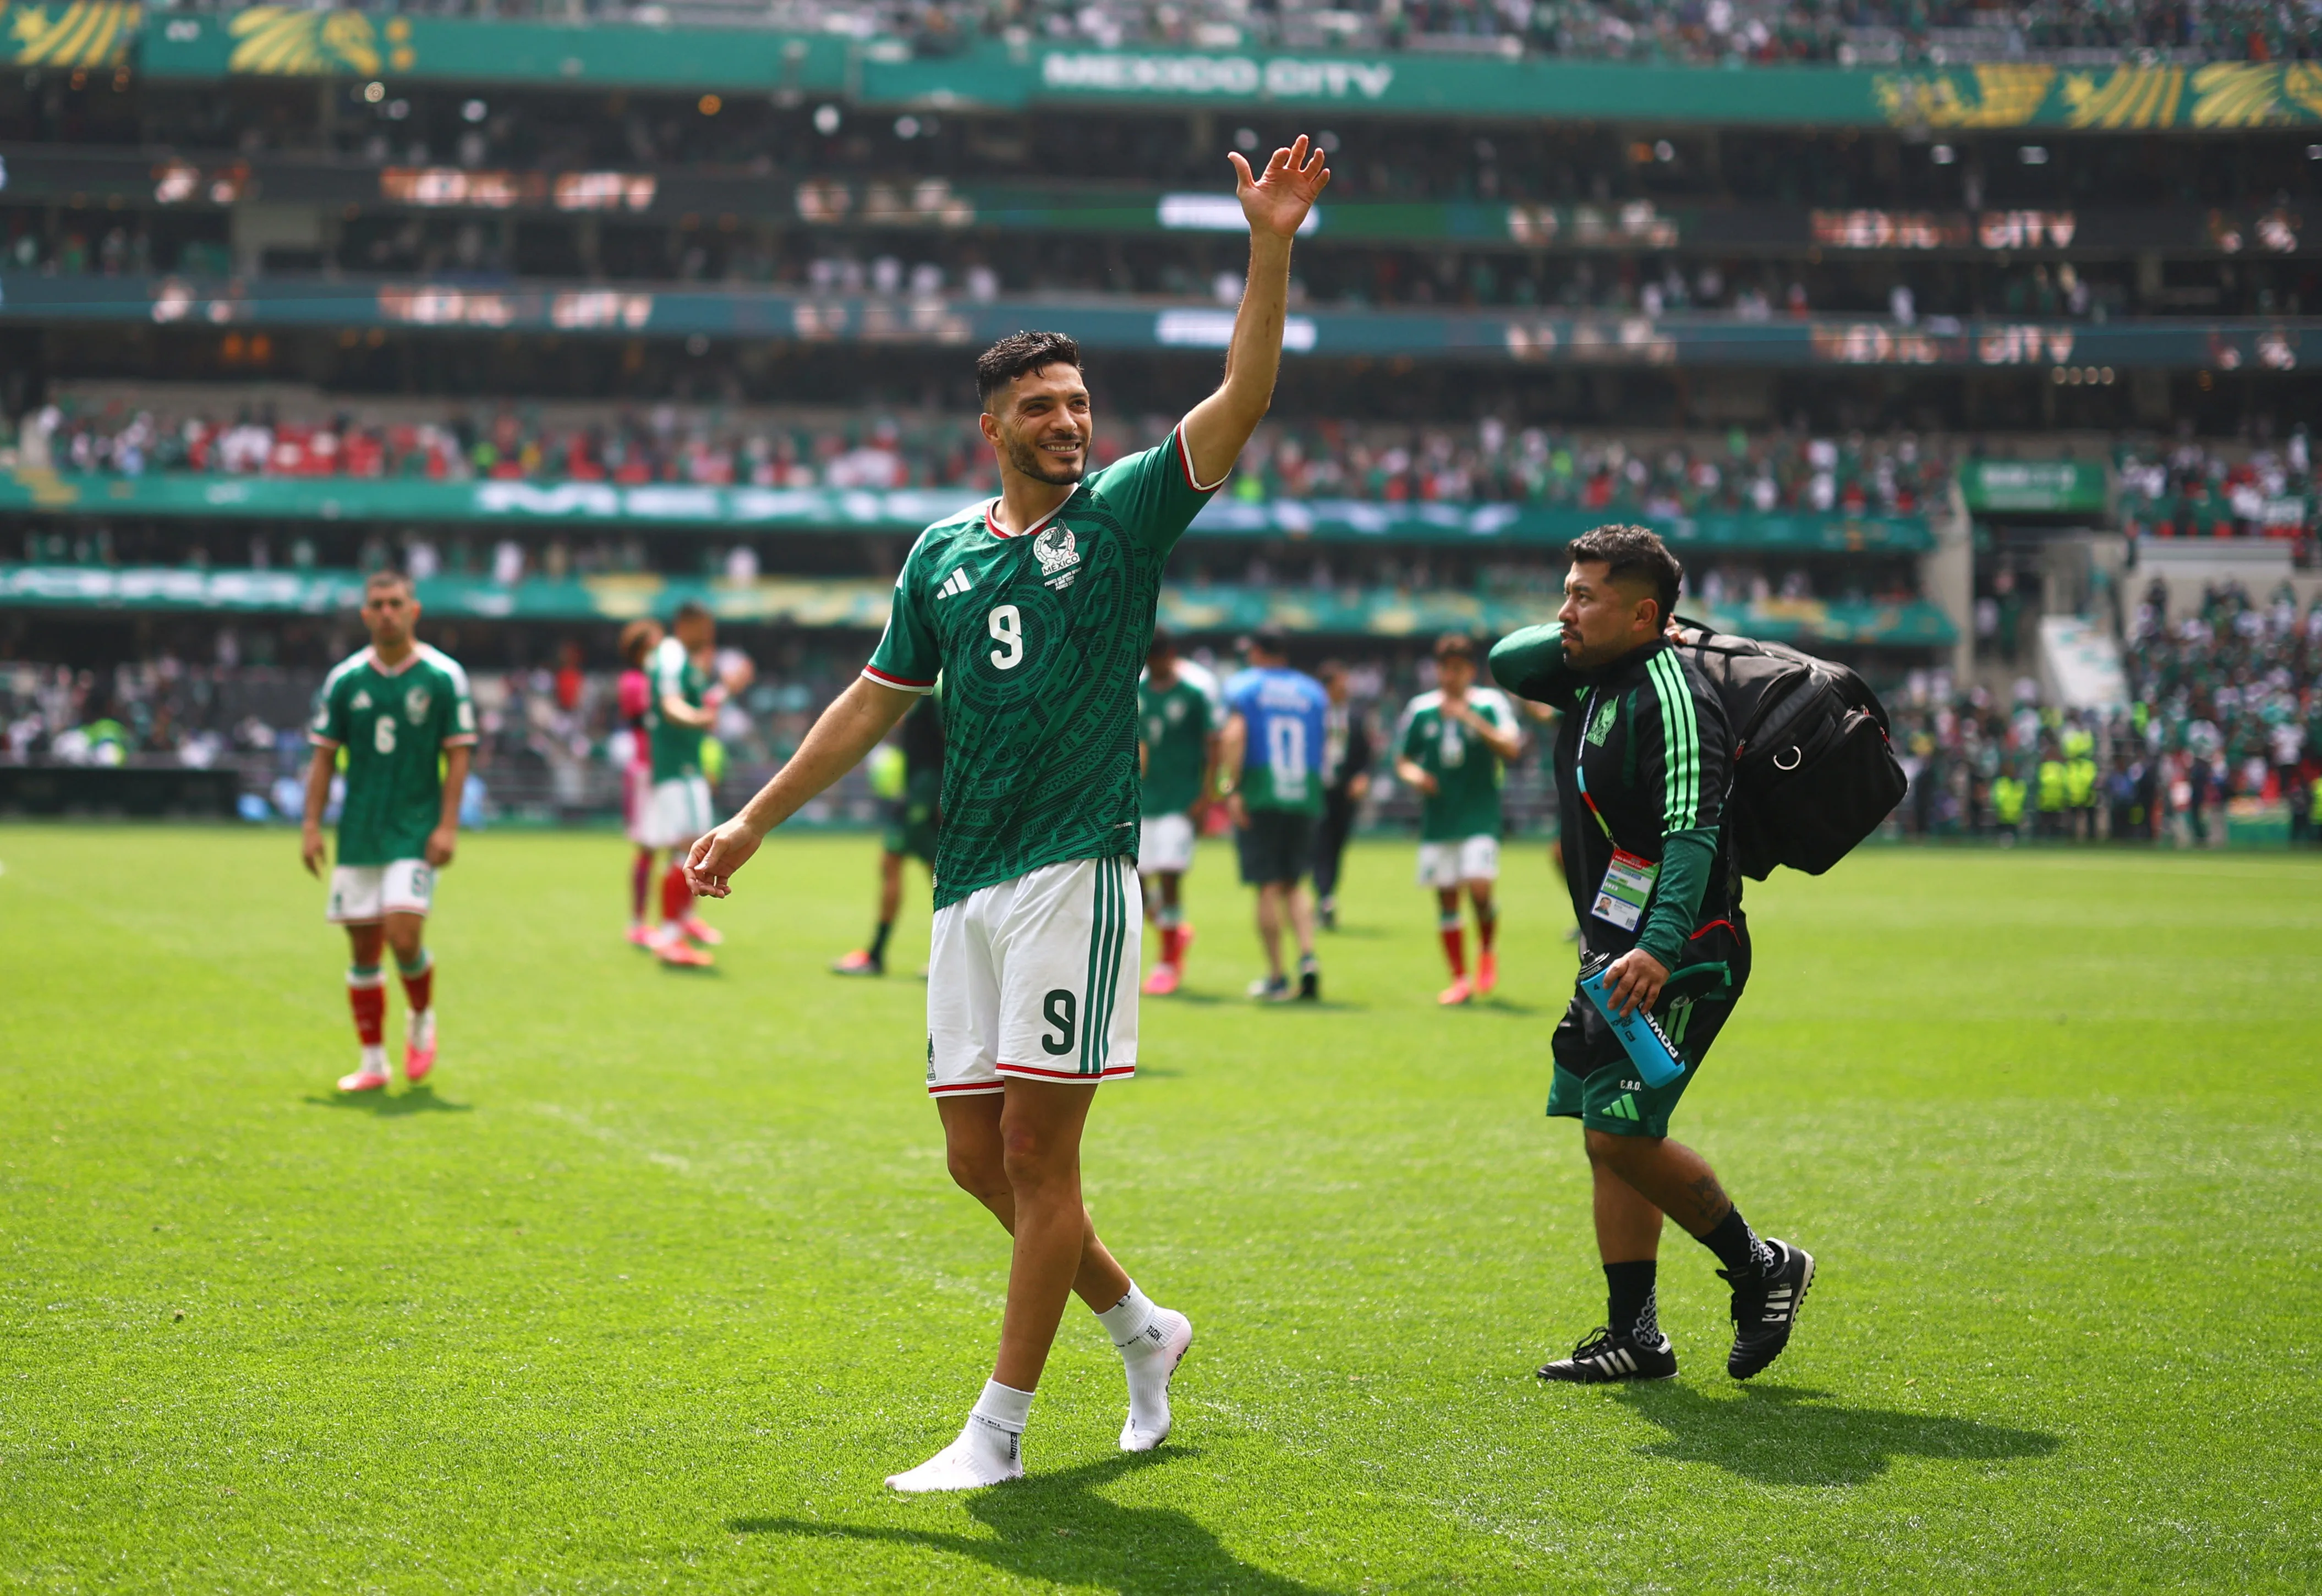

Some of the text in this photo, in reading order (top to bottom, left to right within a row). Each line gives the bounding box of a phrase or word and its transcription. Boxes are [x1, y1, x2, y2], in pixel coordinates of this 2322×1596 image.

[1045, 53, 1393, 98] MEXICO CITY
[1043, 555, 1078, 574] MÉXICO
[988, 605, 1023, 670] 9
[375, 716, 396, 754] 6
[1042, 989, 1076, 1056] 9
